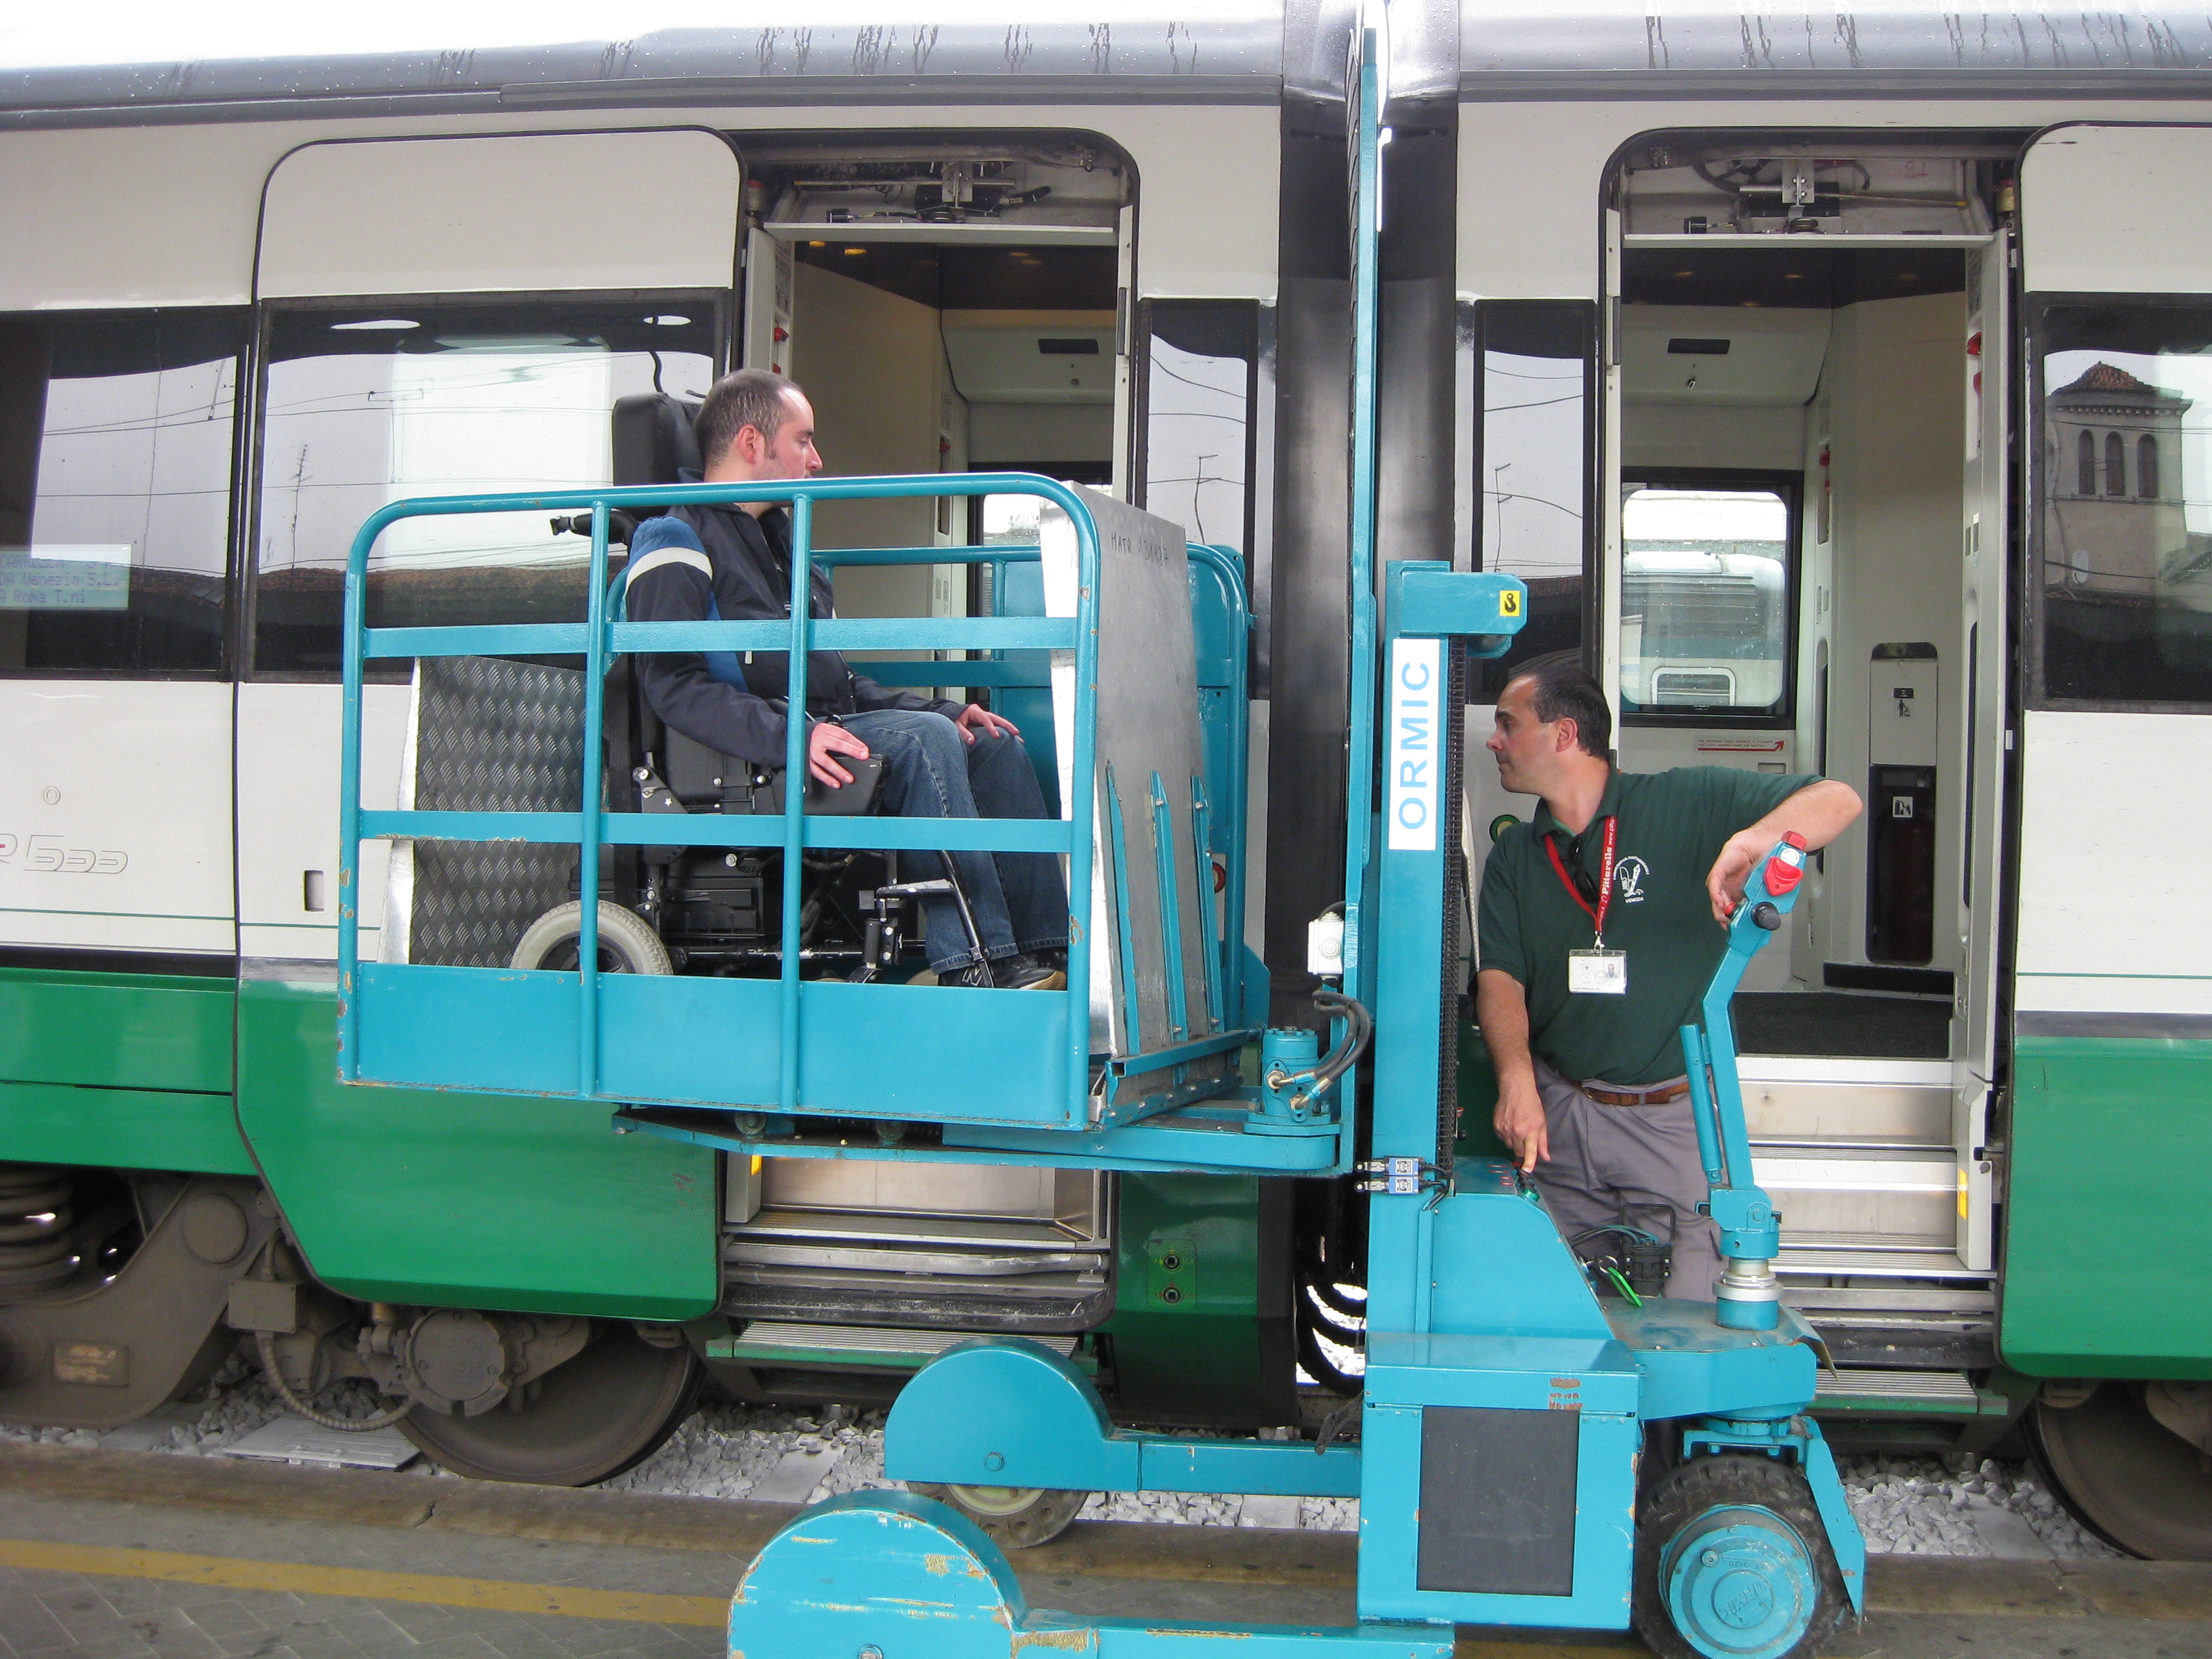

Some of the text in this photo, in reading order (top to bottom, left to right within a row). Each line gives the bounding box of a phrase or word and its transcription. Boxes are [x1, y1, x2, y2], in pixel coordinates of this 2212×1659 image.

[14, 590, 47, 604] Roma
[1398, 661, 1430, 830] ORMIC
[1601, 846, 1614, 895] Pittarello
